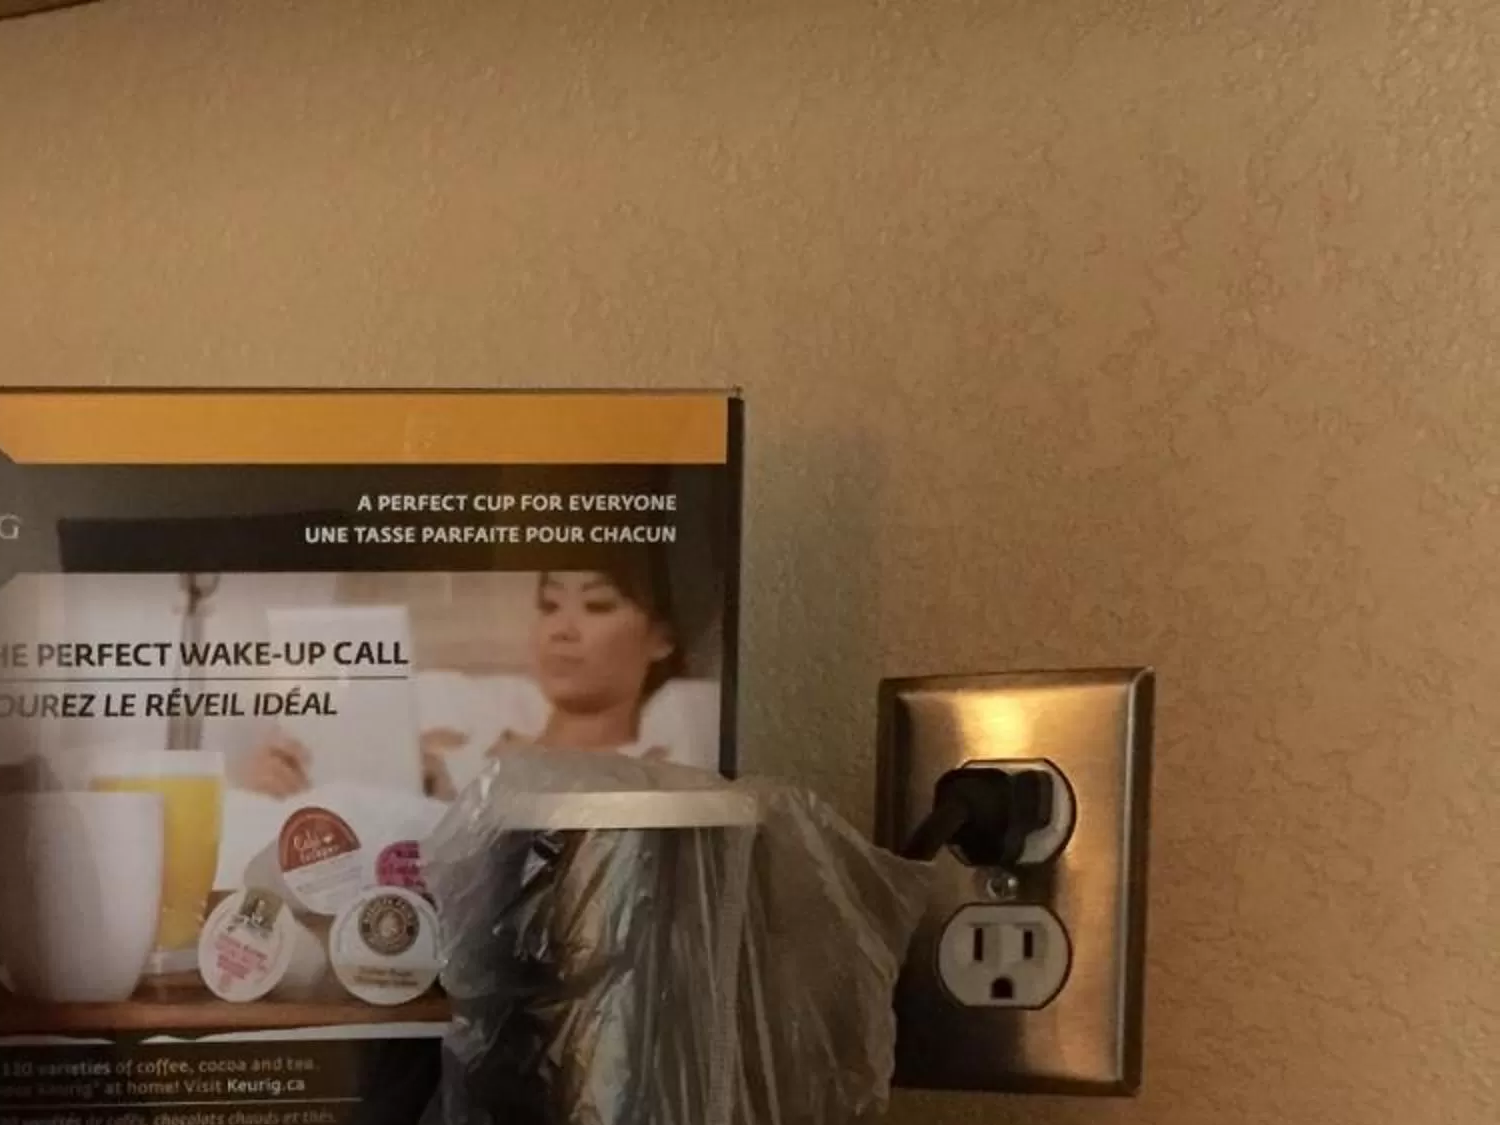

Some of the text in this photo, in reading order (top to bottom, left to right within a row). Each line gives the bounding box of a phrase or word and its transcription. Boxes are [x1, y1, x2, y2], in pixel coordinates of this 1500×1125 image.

[357, 494, 677, 512] A PERFECT CUP FOR EVERYONE
[304, 526, 677, 544] UNE TASSE PARFAITE POUR CHACUN
[36, 642, 172, 668] PERFECT
[179, 641, 327, 667] WAKE-UP
[333, 640, 410, 665] CALL
[103, 692, 137, 718] LE
[144, 687, 245, 717] RÉVEIL
[253, 687, 338, 717] IDÉAL
[115, 1059, 133, 1076] of
[136, 1058, 195, 1076] coffee,
[199, 1059, 247, 1073] cocoa
[251, 1057, 285, 1073] and
[126, 1080, 180, 1094] home!
[185, 1080, 223, 1094] Visit
[227, 1078, 306, 1095] Keurig.ca
